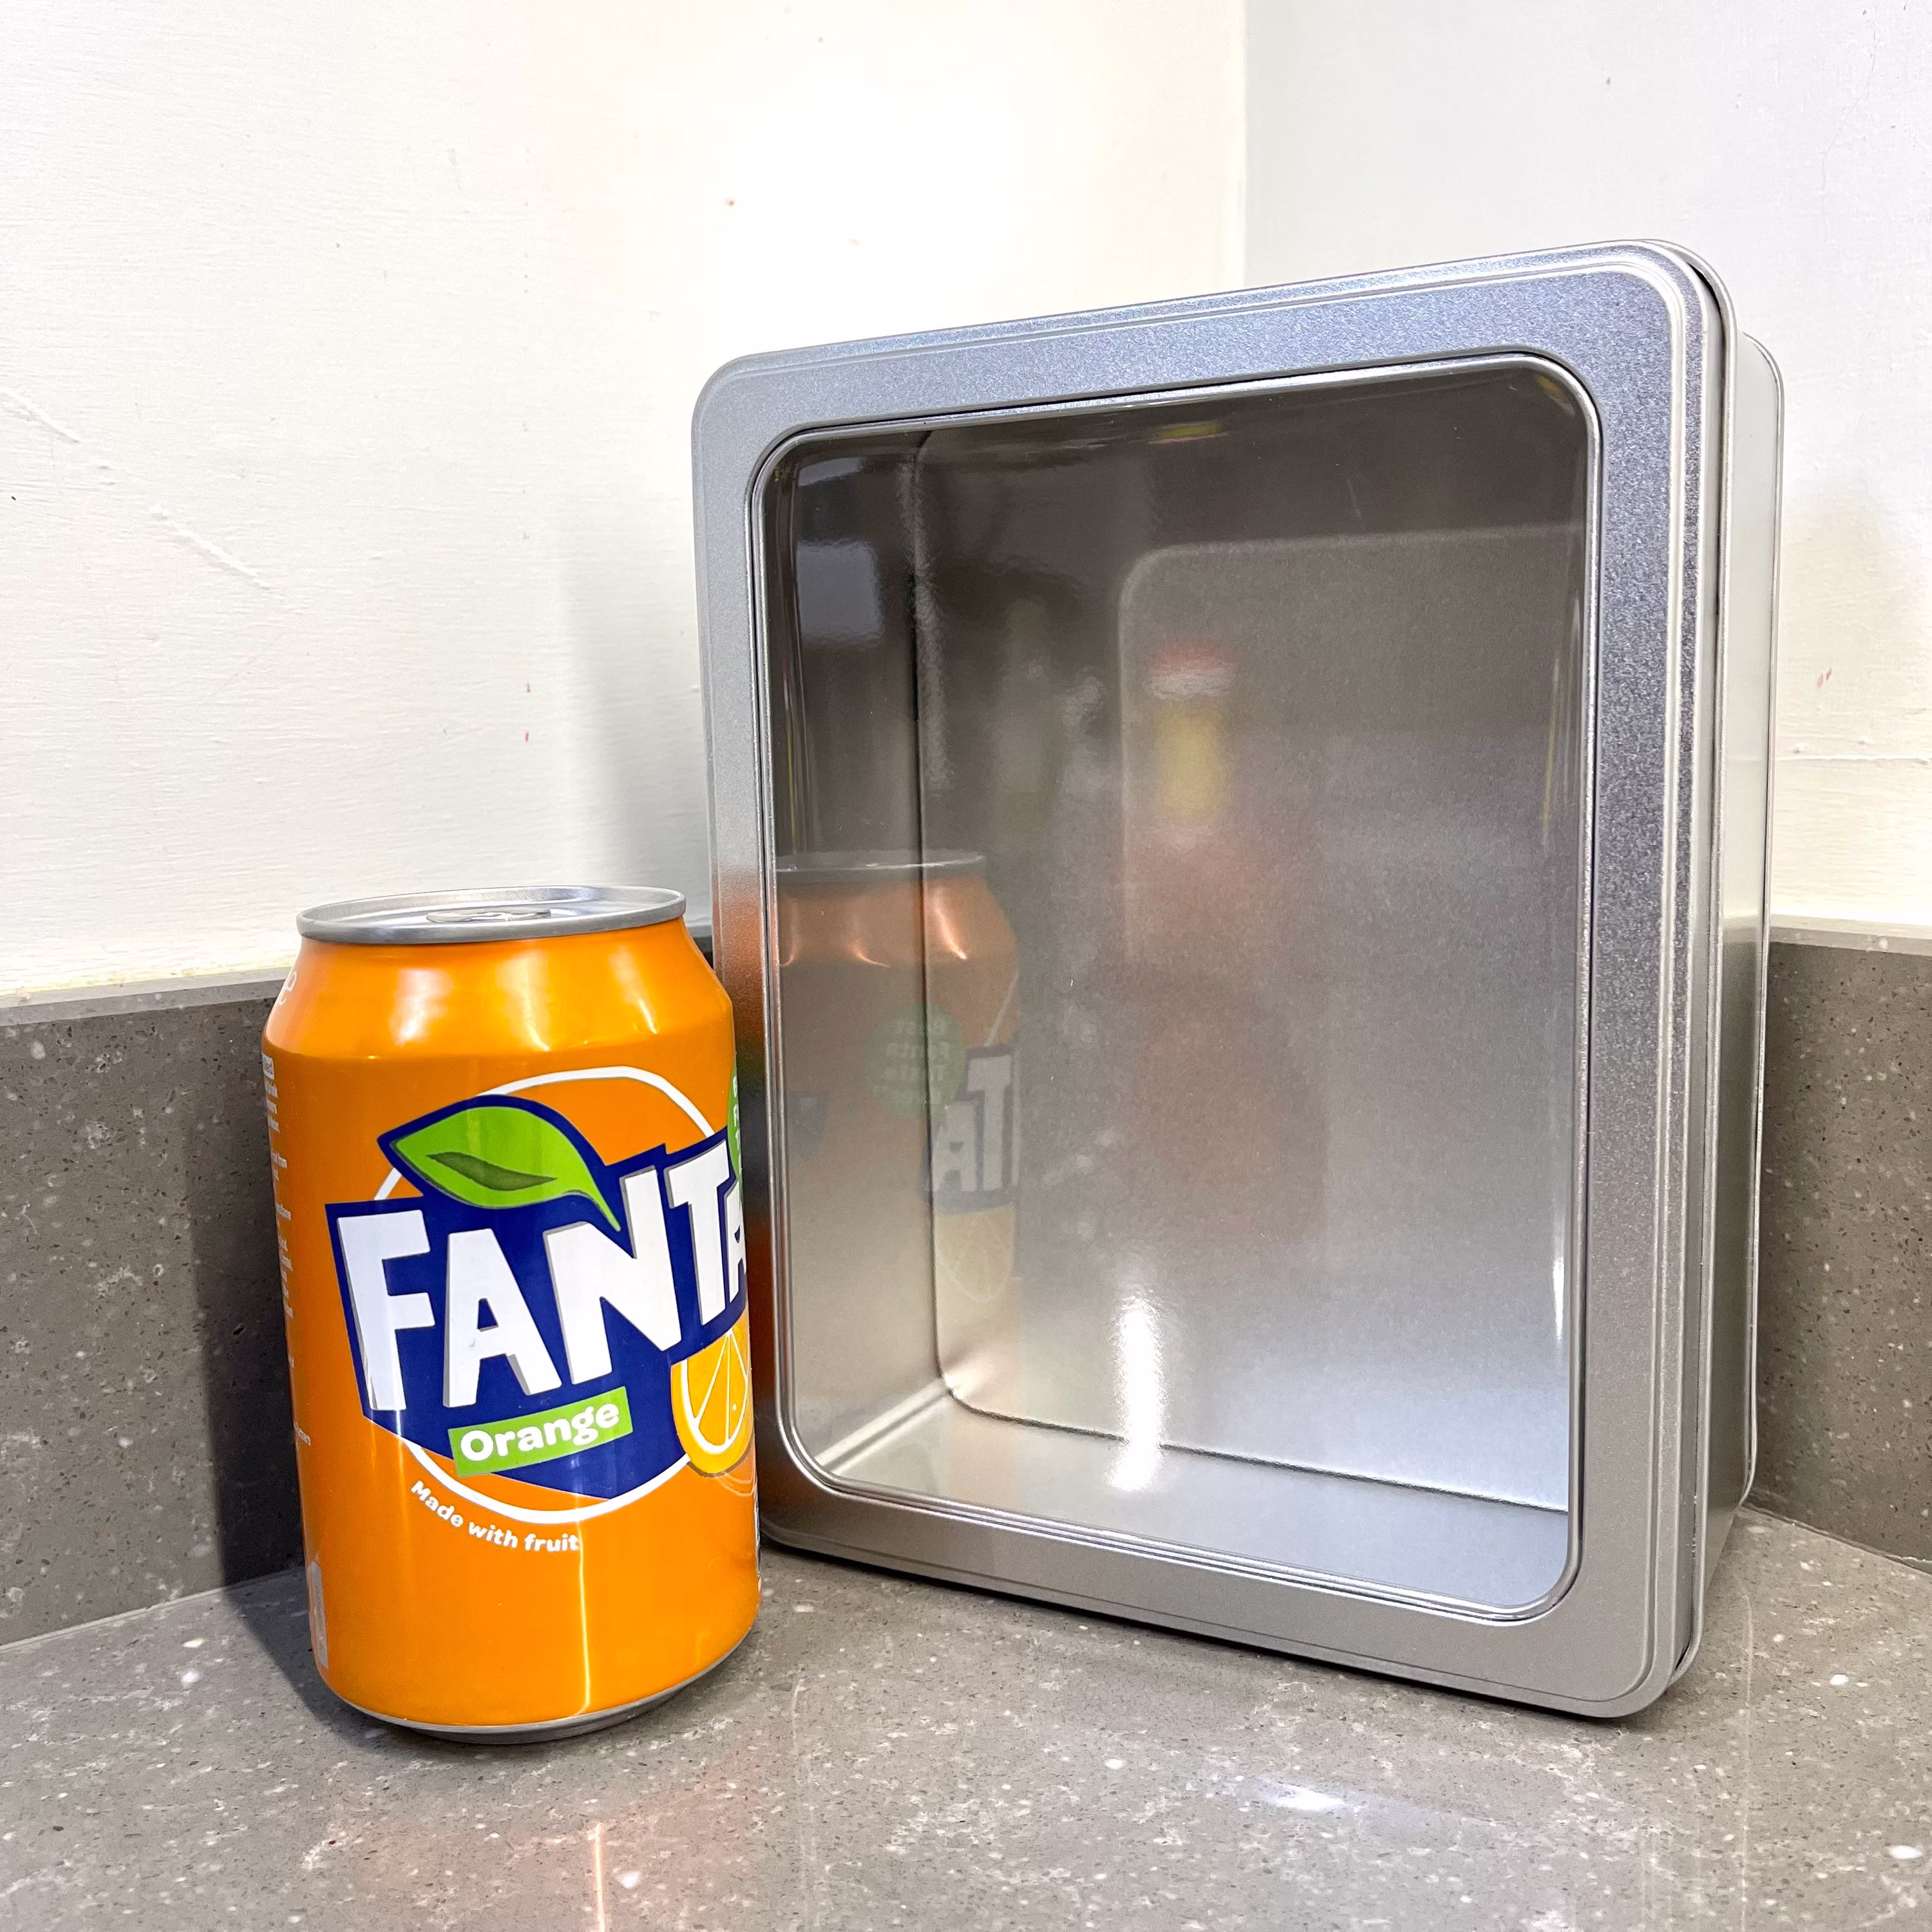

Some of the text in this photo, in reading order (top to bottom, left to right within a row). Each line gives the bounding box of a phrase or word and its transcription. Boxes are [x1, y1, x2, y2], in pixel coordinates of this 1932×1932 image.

[337, 1140, 746, 1410] FANTA
[460, 1403, 620, 1461] Orange
[411, 1480, 580, 1552] Made with fruit
